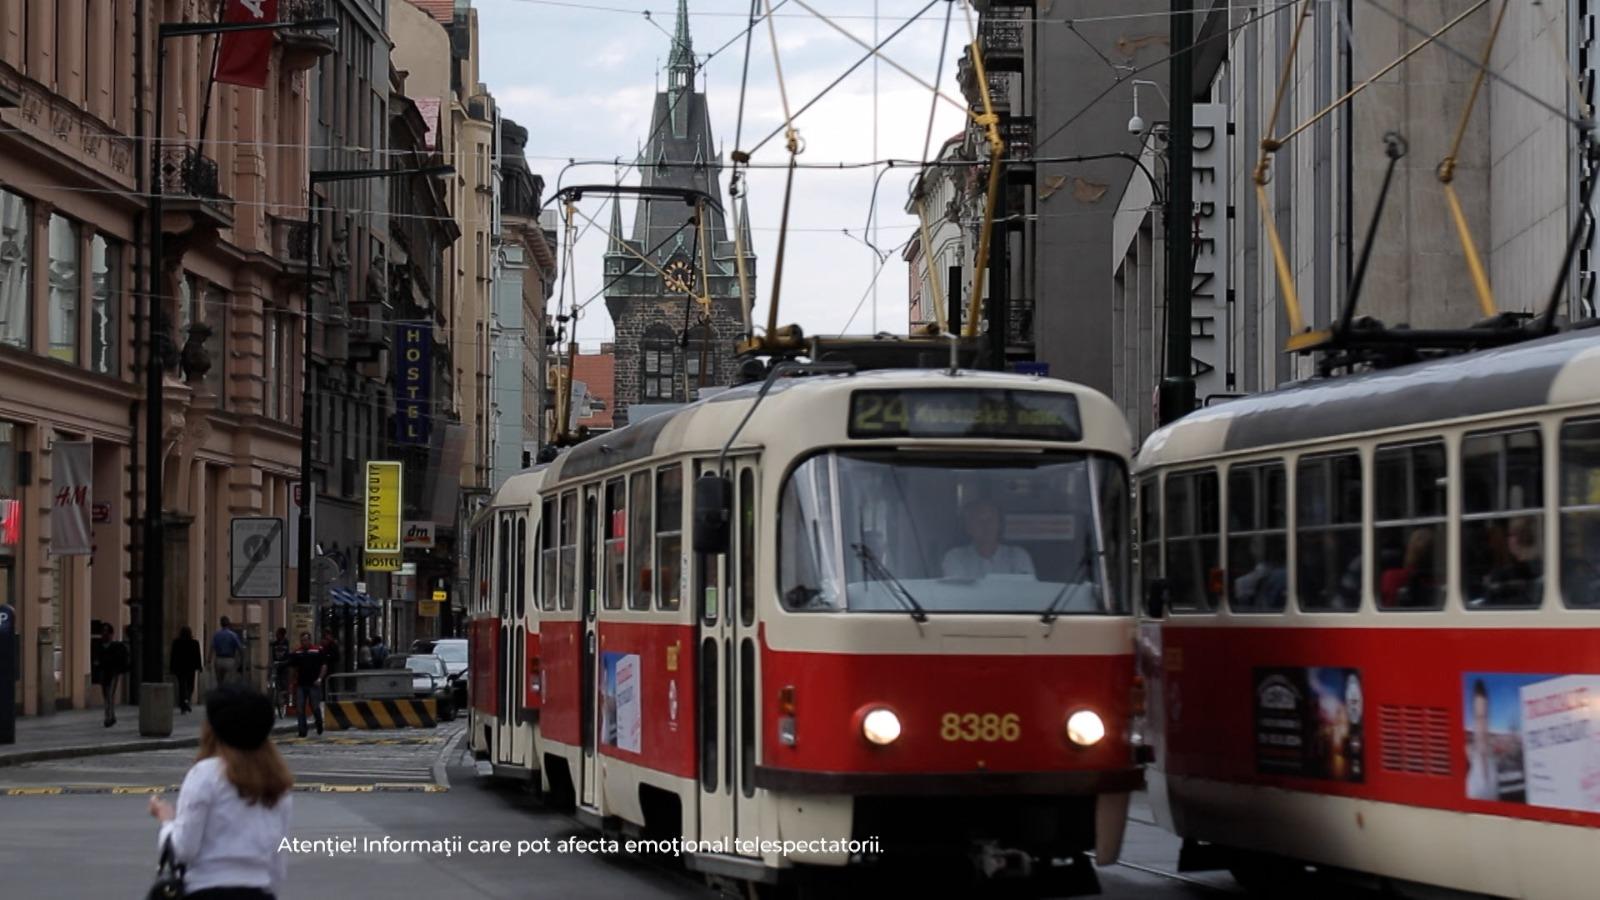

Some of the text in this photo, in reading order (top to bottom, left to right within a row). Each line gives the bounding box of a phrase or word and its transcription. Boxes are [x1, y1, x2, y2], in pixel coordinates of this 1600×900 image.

[406, 330, 420, 437] HOSTEL
[855, 394, 909, 430] 24
[407, 524, 428, 537] dm
[365, 557, 399, 567] HOSTEL
[940, 712, 1021, 742] 8386
